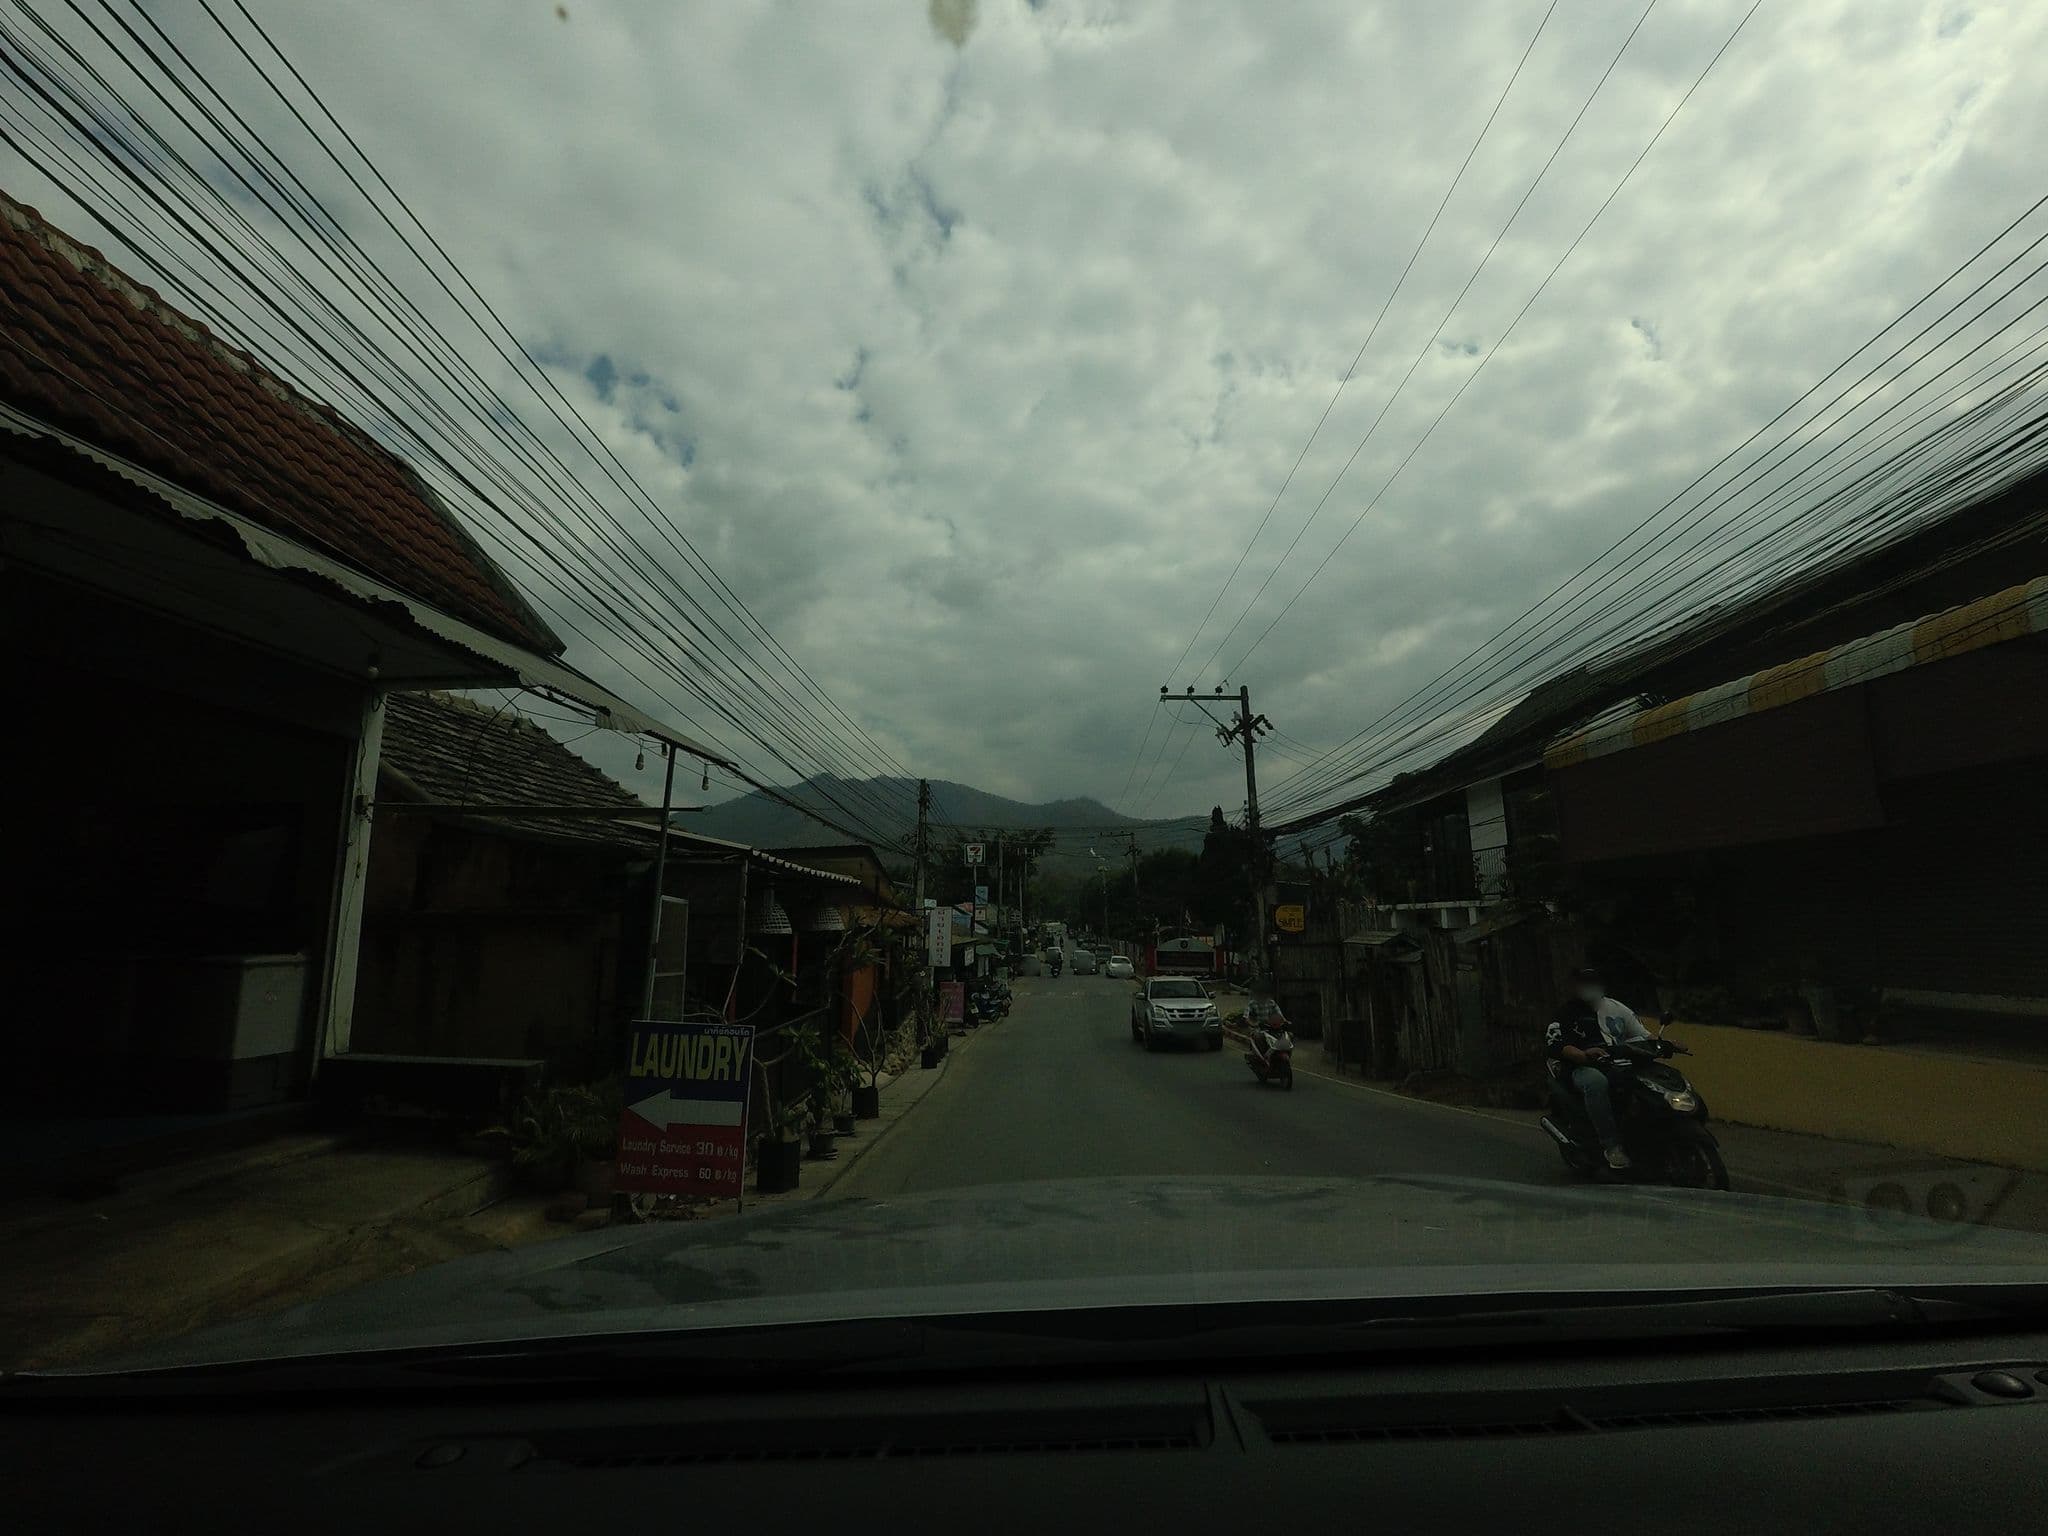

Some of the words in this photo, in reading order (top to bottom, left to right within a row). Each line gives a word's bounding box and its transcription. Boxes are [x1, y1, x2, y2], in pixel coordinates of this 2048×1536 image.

[630, 1032, 750, 1081] LAUNDRY
[622, 1136, 655, 1157] Laundry
[660, 1139, 691, 1155] Service
[620, 1162, 647, 1176] Wash
[652, 1164, 689, 1181] Express
[699, 1167, 711, 1179] 60
